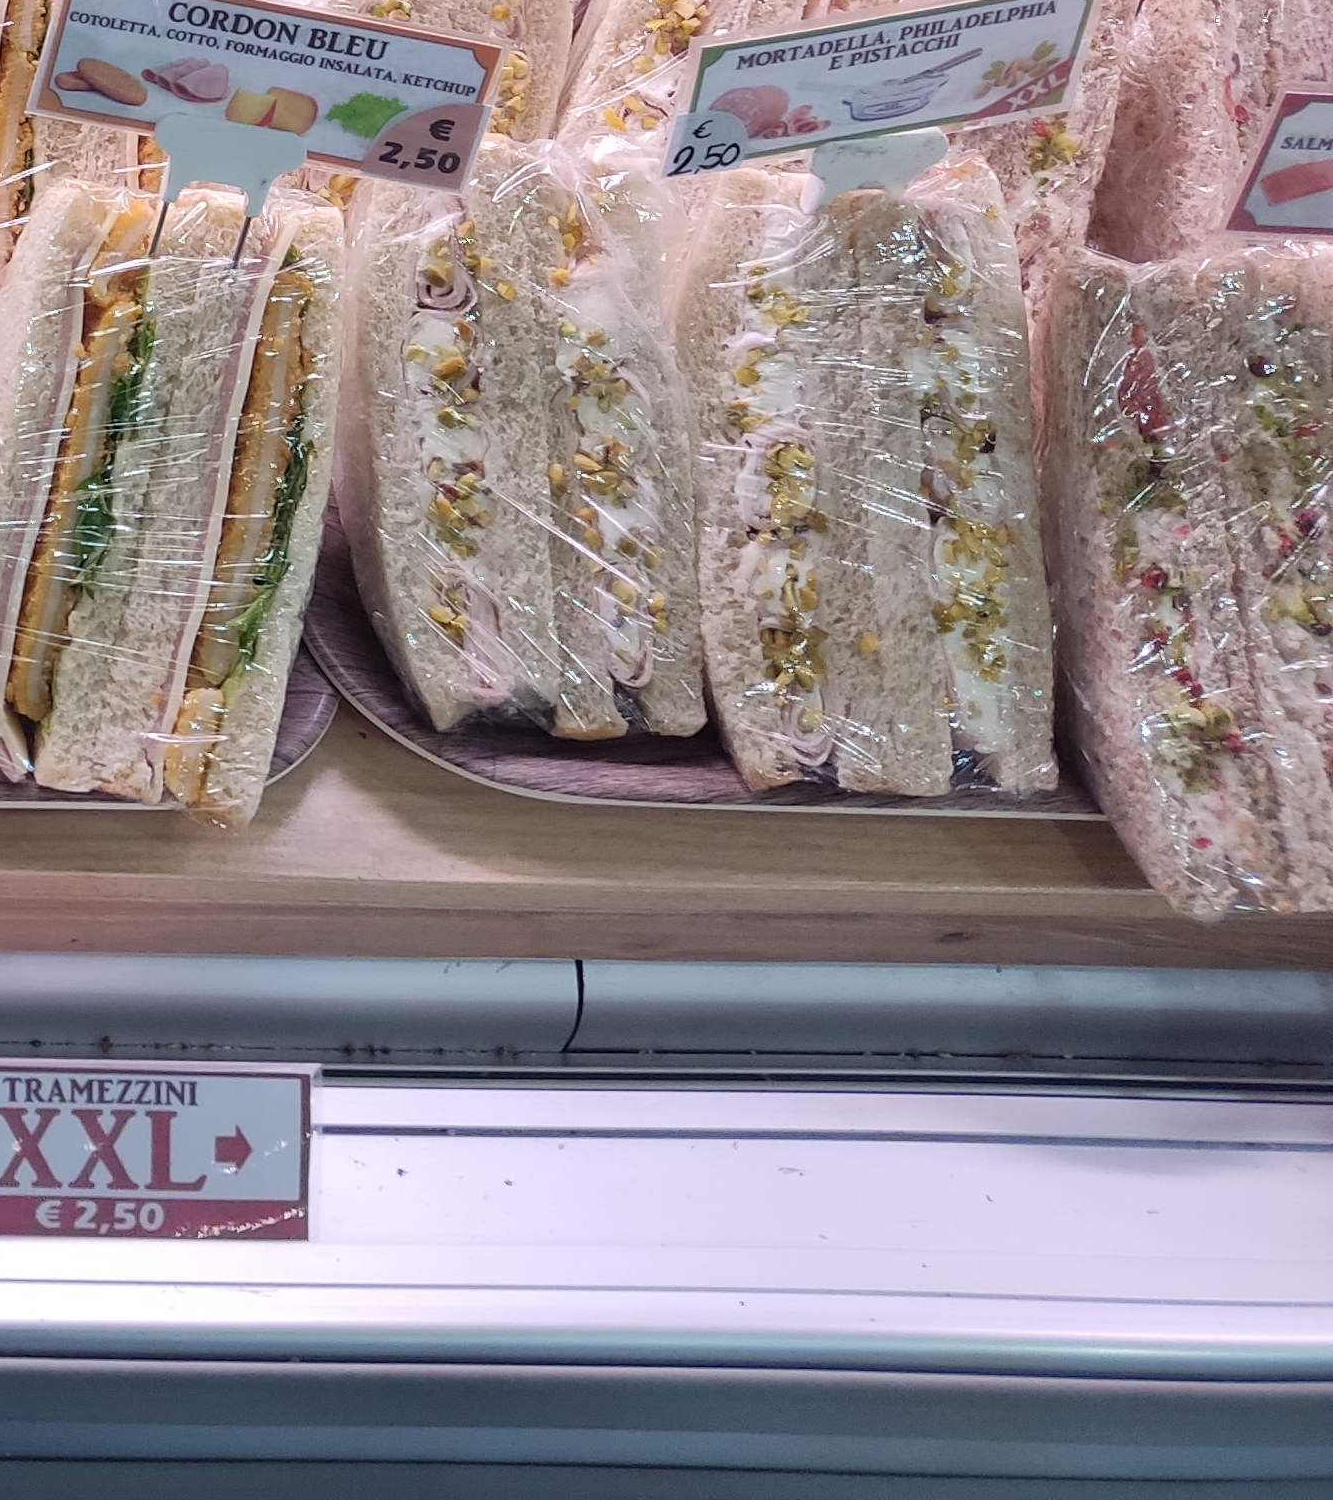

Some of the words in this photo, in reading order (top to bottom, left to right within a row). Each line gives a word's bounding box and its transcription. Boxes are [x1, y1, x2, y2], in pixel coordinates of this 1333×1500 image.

[168, 1, 301, 46] CORDON
[306, 27, 390, 61] BLEU
[736, 29, 891, 71] MORTADELLA,
[899, 0, 1058, 41] PHILADELPHIA
[69, 10, 161, 39] COTOLETTA,
[166, 28, 221, 51] COTTO,
[225, 39, 316, 67] FORMAGGIO
[319, 57, 399, 84] INSALATA,
[402, 72, 476, 98] KETCHUP
[828, 54, 843, 71] E
[846, 33, 963, 68] PISTACCHI
[1007, 67, 1070, 112] XXL
[429, 119, 455, 141] €
[691, 120, 713, 139] €
[378, 140, 460, 175] 2,50
[672, 142, 741, 177] 2,50
[3, 1078, 198, 1106] TRAMEZZINI
[36, 1201, 61, 1229] €
[74, 1201, 164, 1235] 2,50
